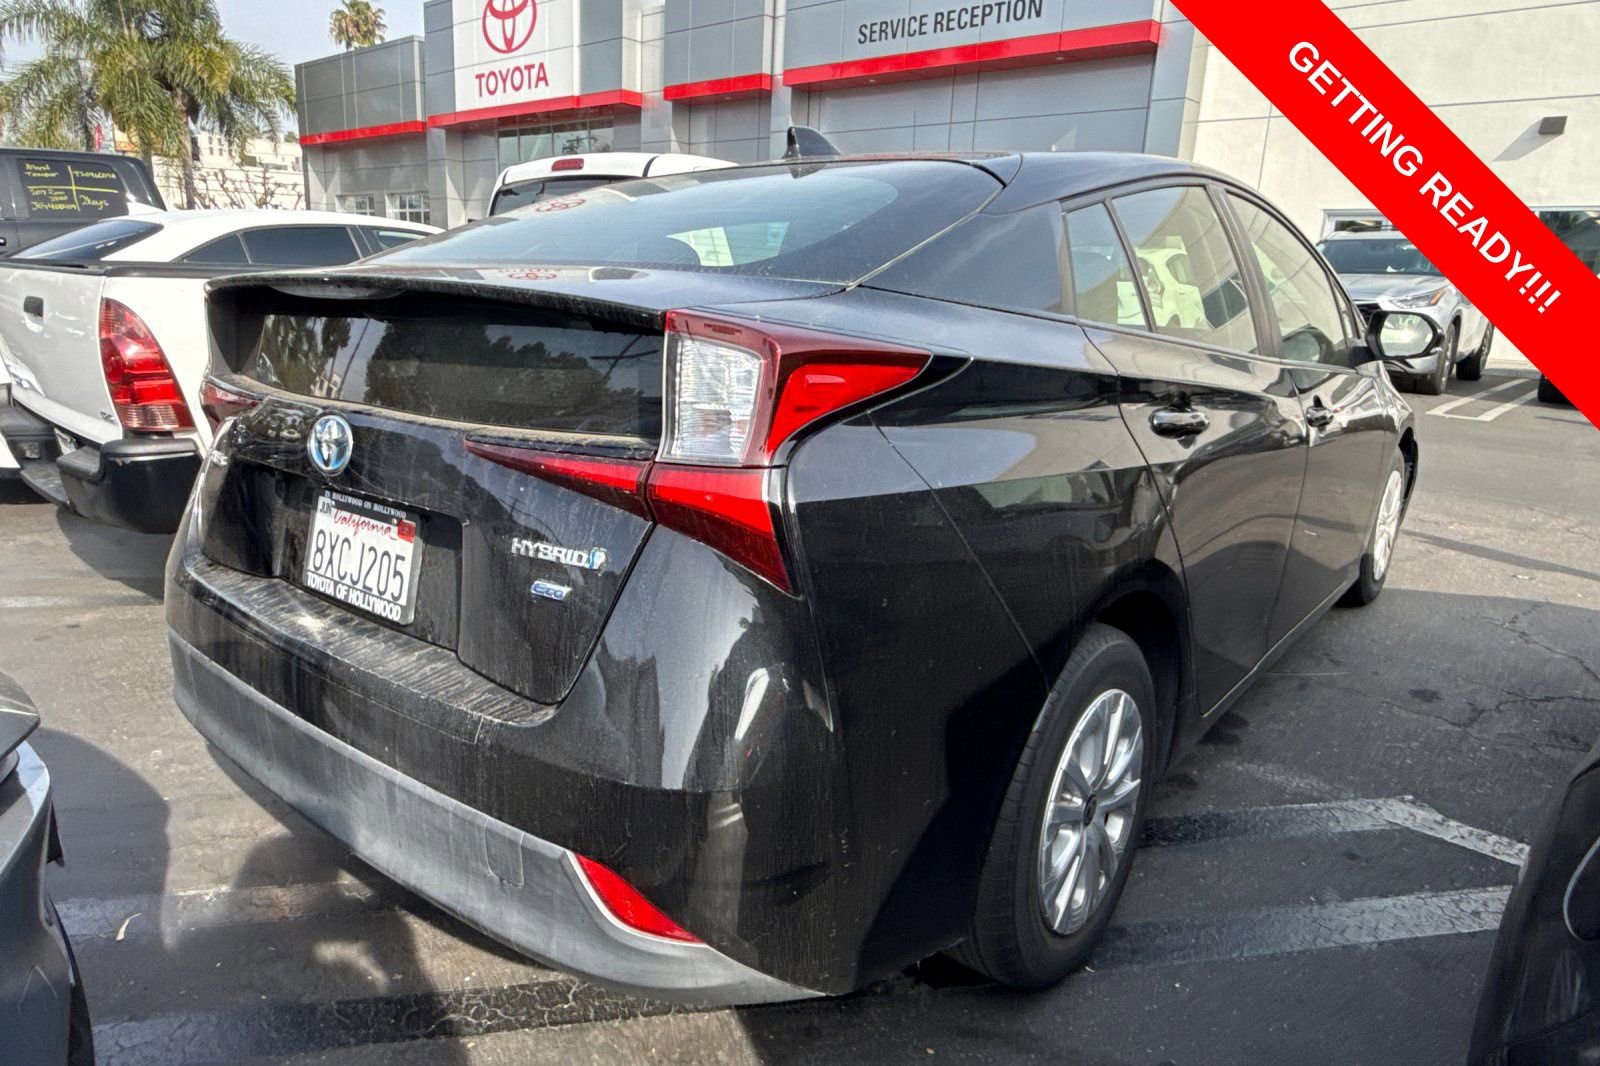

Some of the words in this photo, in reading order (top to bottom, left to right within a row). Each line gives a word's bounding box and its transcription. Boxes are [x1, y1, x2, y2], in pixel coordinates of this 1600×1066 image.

[858, 14, 928, 45] SERVICE
[933, 0, 1043, 34] RECEPTION
[475, 62, 549, 97] TOYOTA
[332, 491, 363, 507] HOLLYWOOD
[363, 500, 372, 509] ON
[373, 502, 407, 519] HOLLYWOOD
[333, 509, 397, 541] California
[313, 529, 406, 602] 8XCJ205
[511, 537, 589, 568] HYBRID
[307, 571, 335, 597] TOYOTA
[335, 583, 349, 600] OF
[348, 588, 402, 621] HOLLYWOOD
